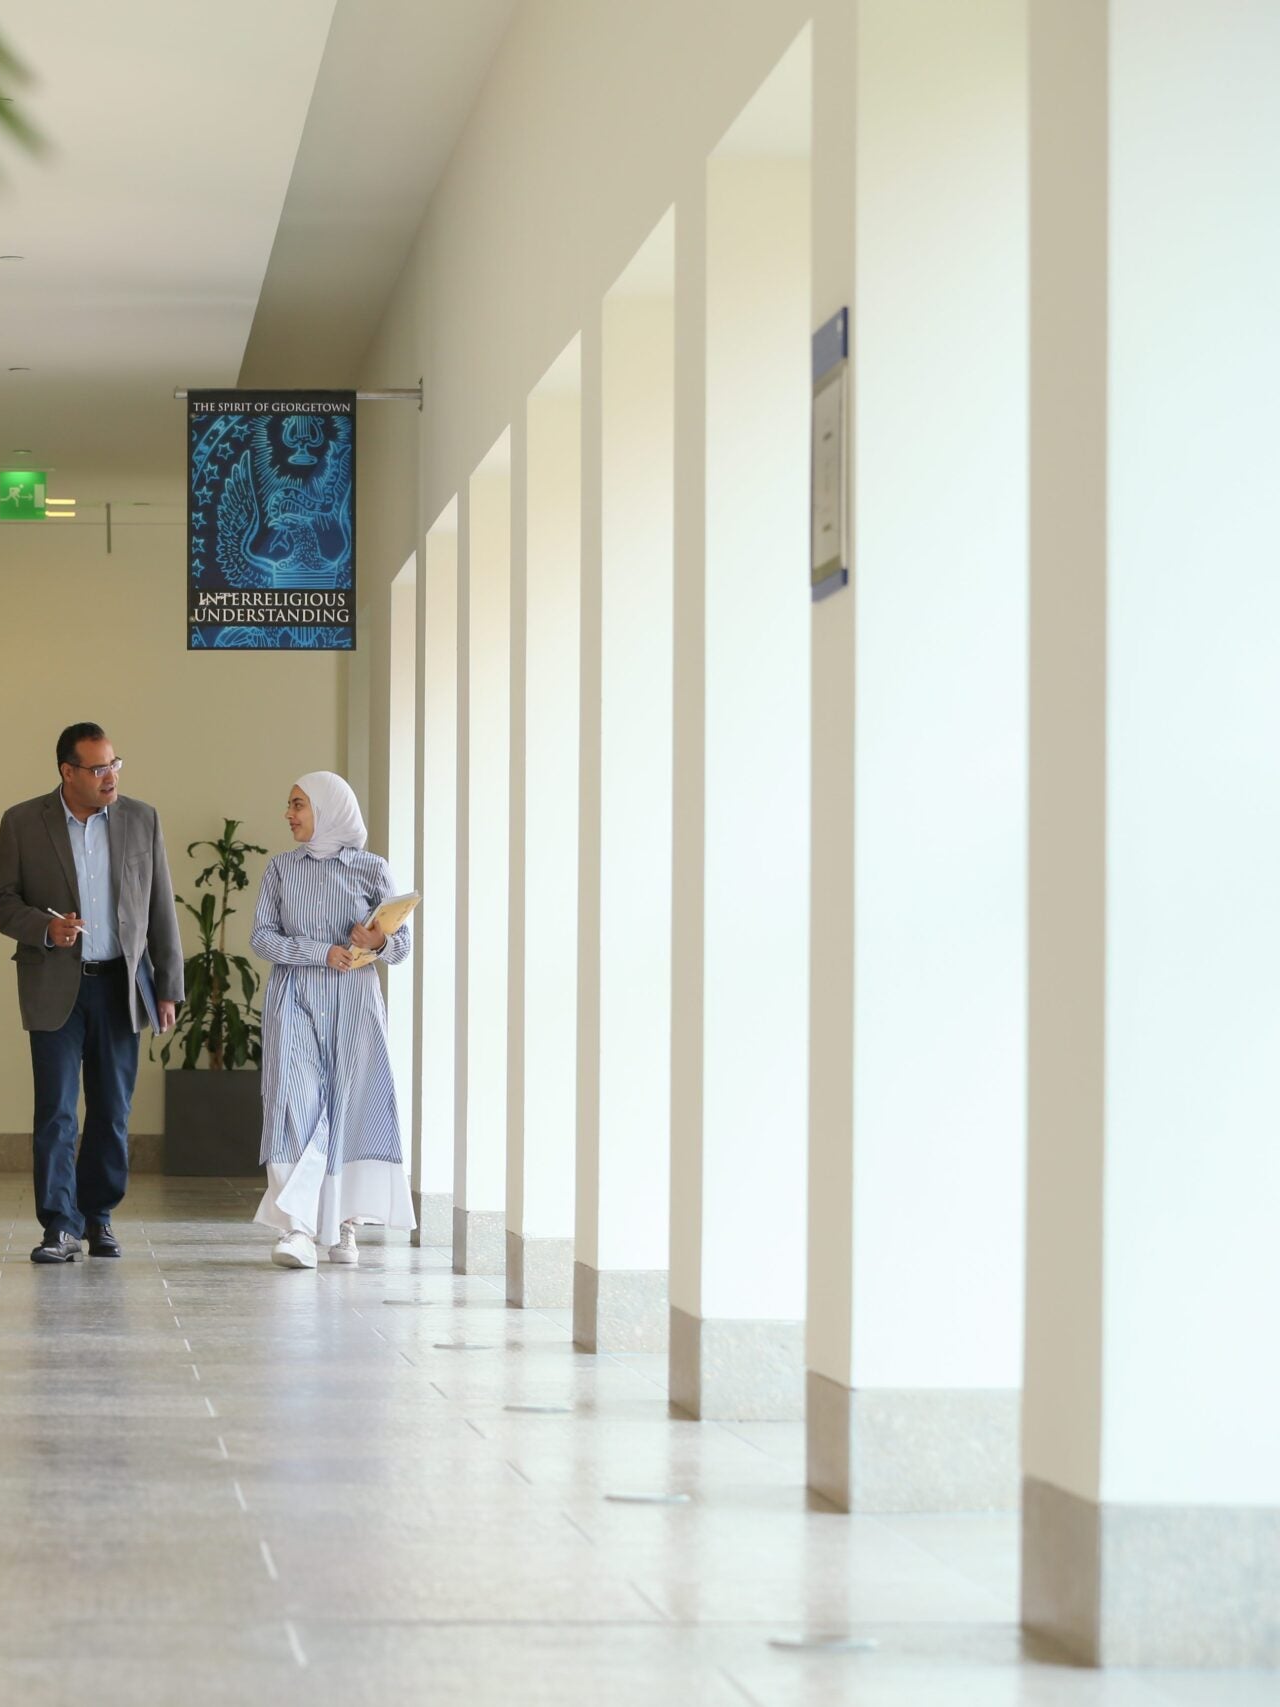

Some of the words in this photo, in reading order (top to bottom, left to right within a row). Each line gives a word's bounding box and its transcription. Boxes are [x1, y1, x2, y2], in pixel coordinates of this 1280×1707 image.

[193, 402, 215, 412] THE
[218, 402, 252, 412] SPIRIT
[254, 402, 269, 412] OF
[271, 402, 351, 412] GEORGETOWN
[198, 592, 346, 606] INTERRELIGIOUS
[194, 608, 350, 622] UNDERSTANDING
